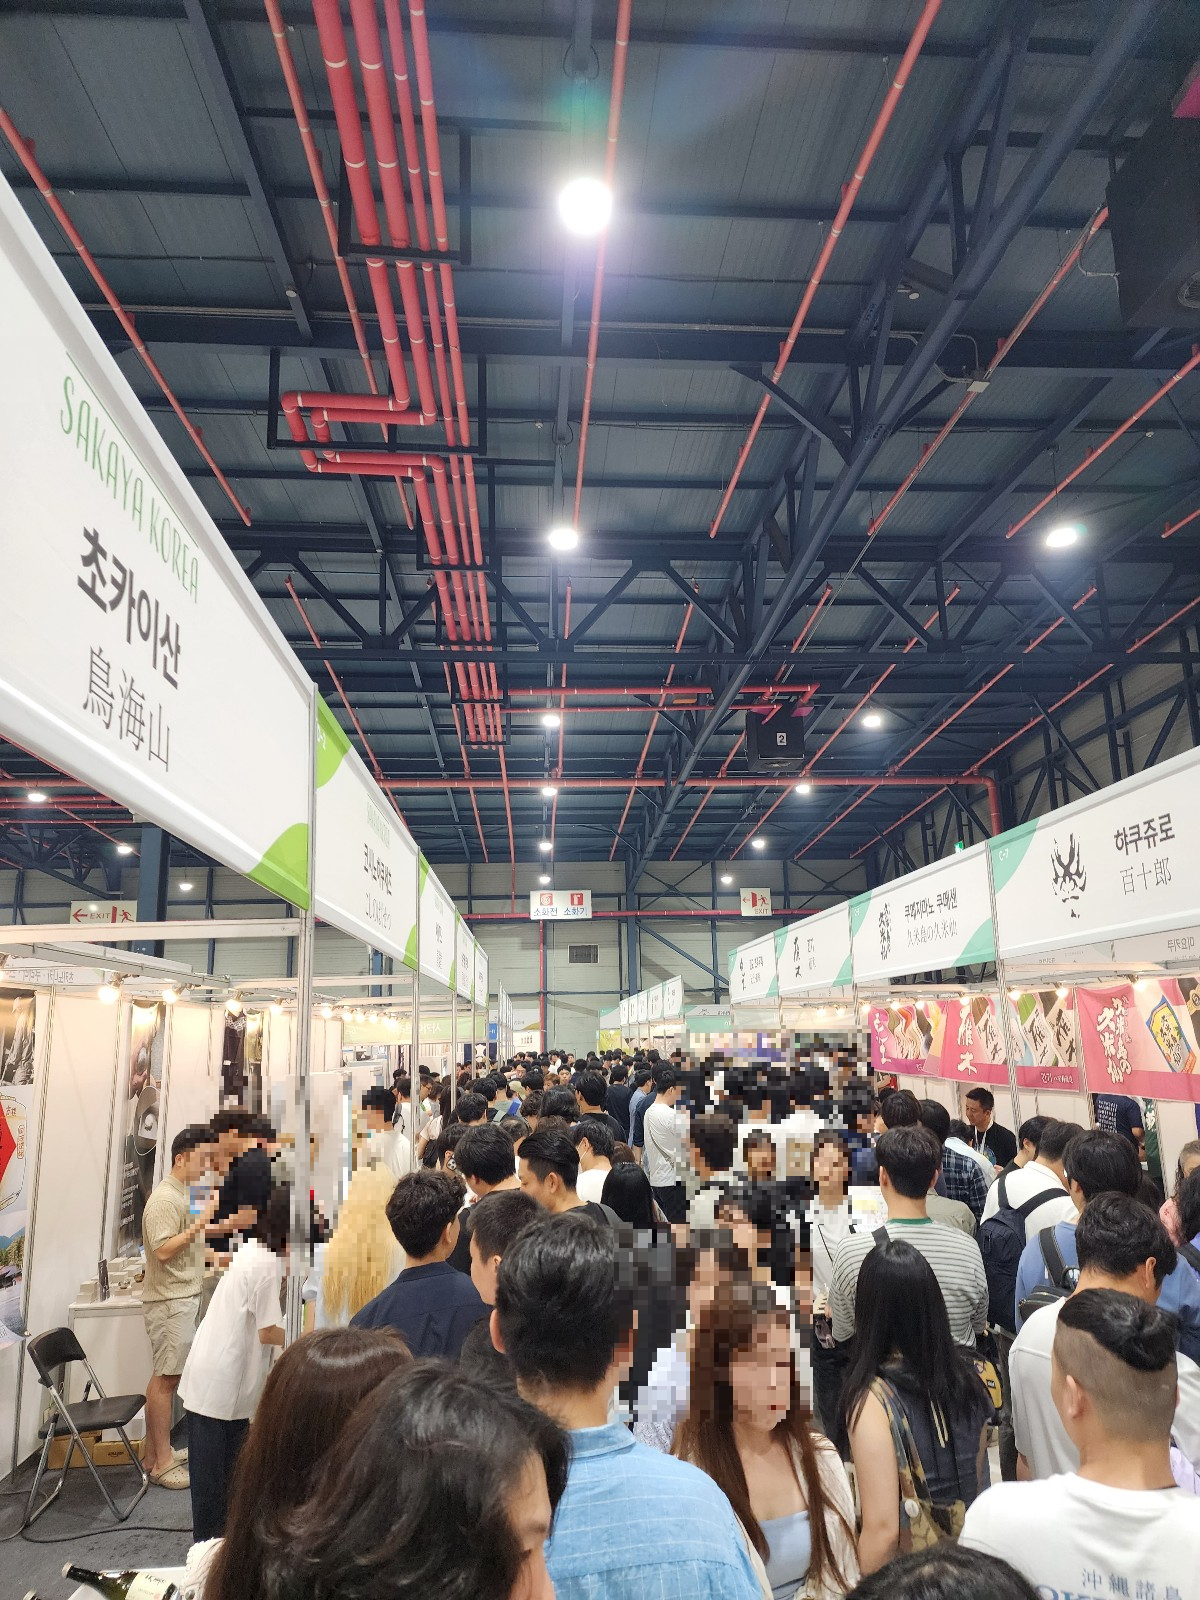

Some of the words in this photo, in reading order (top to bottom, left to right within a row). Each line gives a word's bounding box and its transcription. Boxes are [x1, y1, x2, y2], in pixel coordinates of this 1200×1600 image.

[60, 375, 144, 532] SAKAYA
[149, 497, 199, 604] KOREA
[77, 527, 180, 689] 초카이산
[83, 646, 171, 773] 鳥海山
[778, 734, 786, 743] 2
[1113, 812, 1176, 856] 햐쿠쥬로
[1119, 857, 1172, 896] 百十郎
[90, 912, 111, 920] EXIT
[533, 907, 558, 917] 소화전
[563, 906, 588, 916] 소화기
